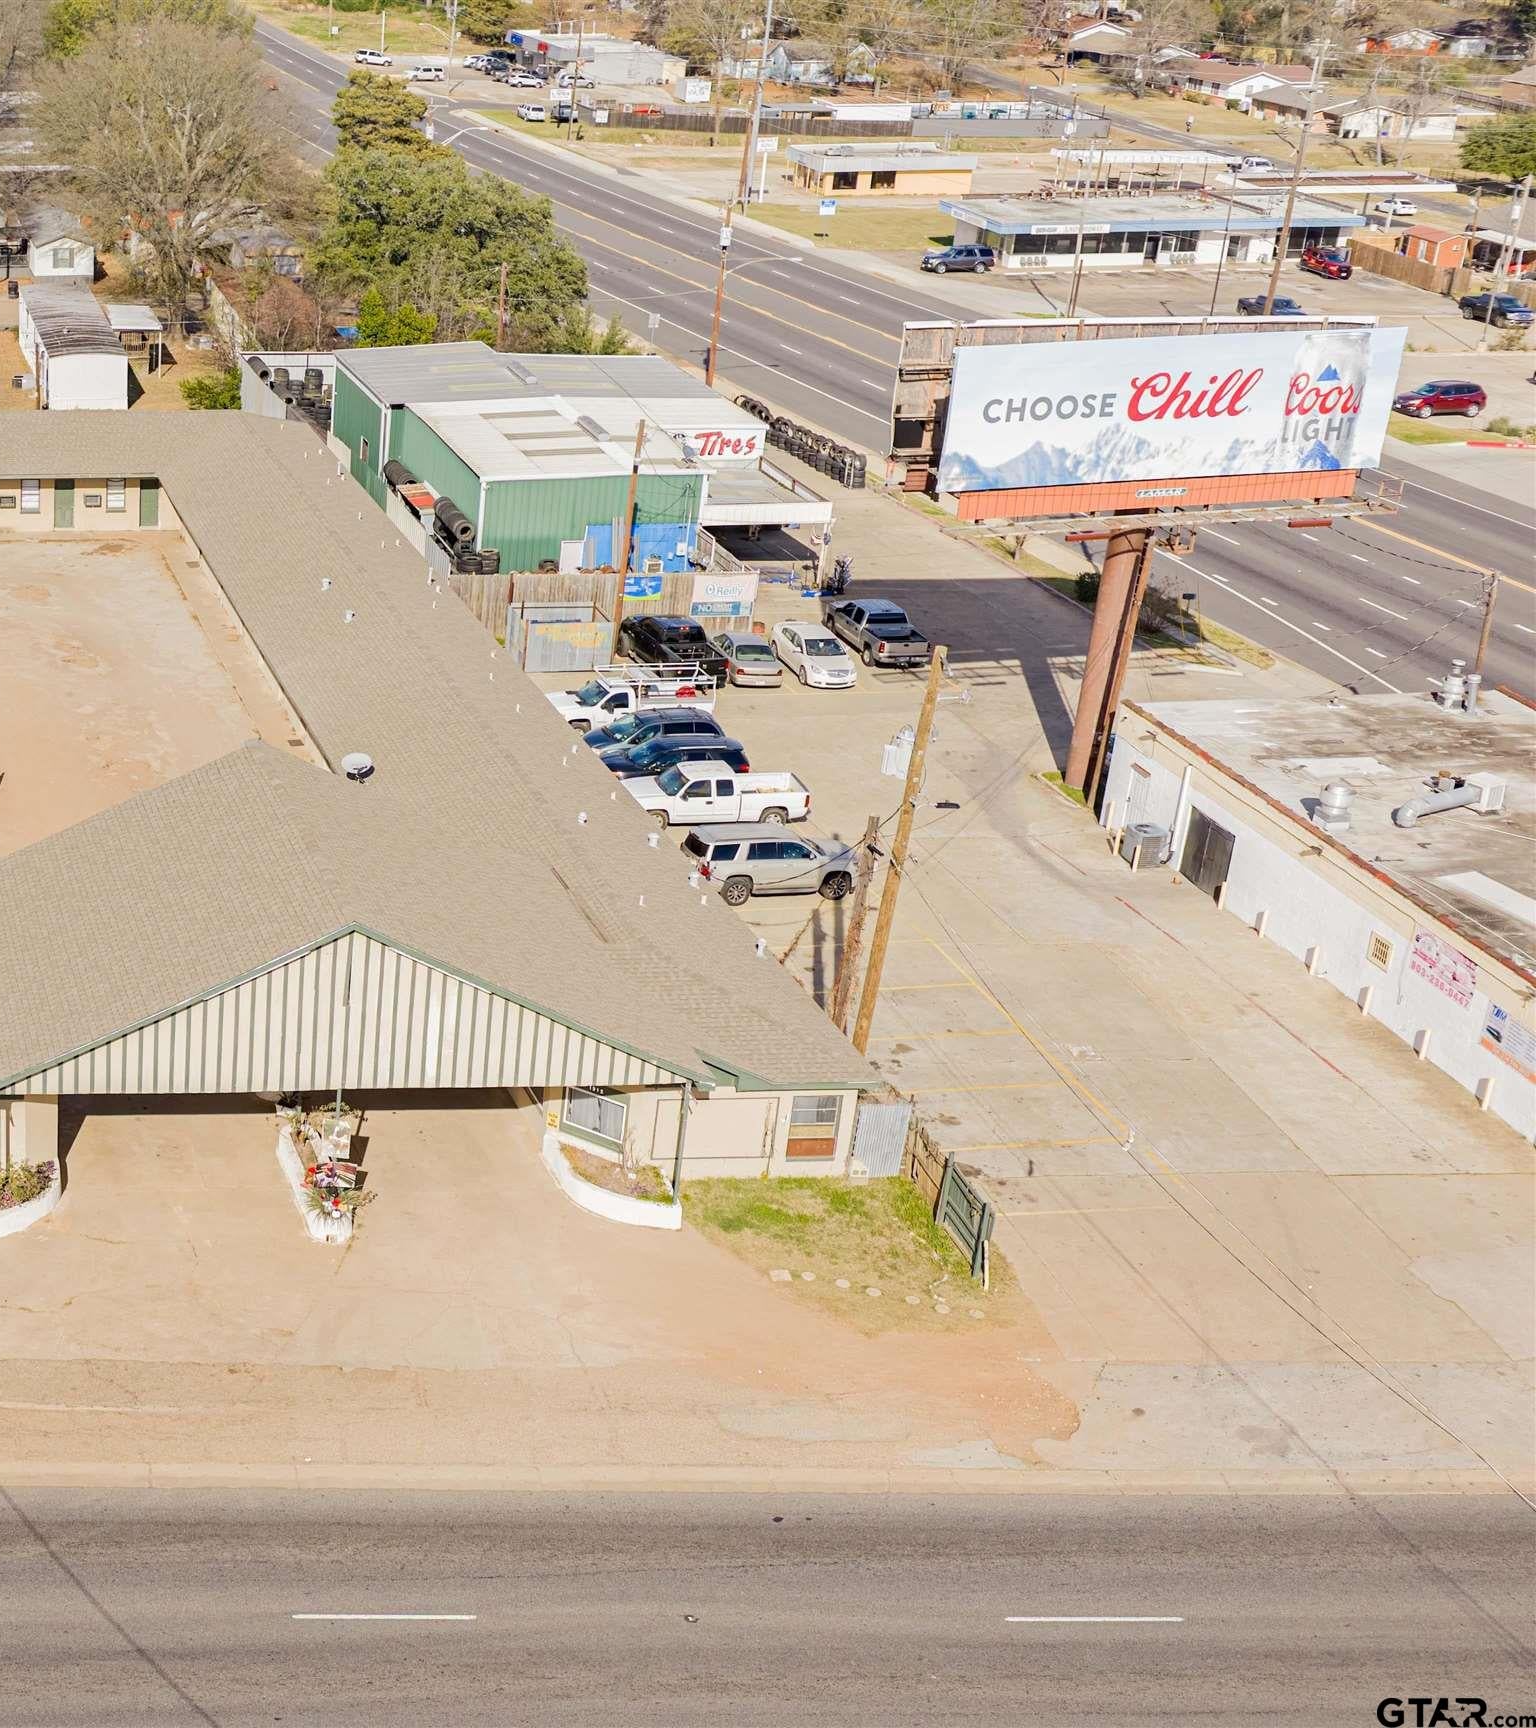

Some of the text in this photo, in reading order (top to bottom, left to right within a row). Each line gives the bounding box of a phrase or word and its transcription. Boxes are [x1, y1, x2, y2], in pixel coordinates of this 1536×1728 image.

[983, 368, 1264, 424] CHOOSE Chill
[1281, 416, 1357, 443] LIGHT
[694, 431, 757, 456] Tires
